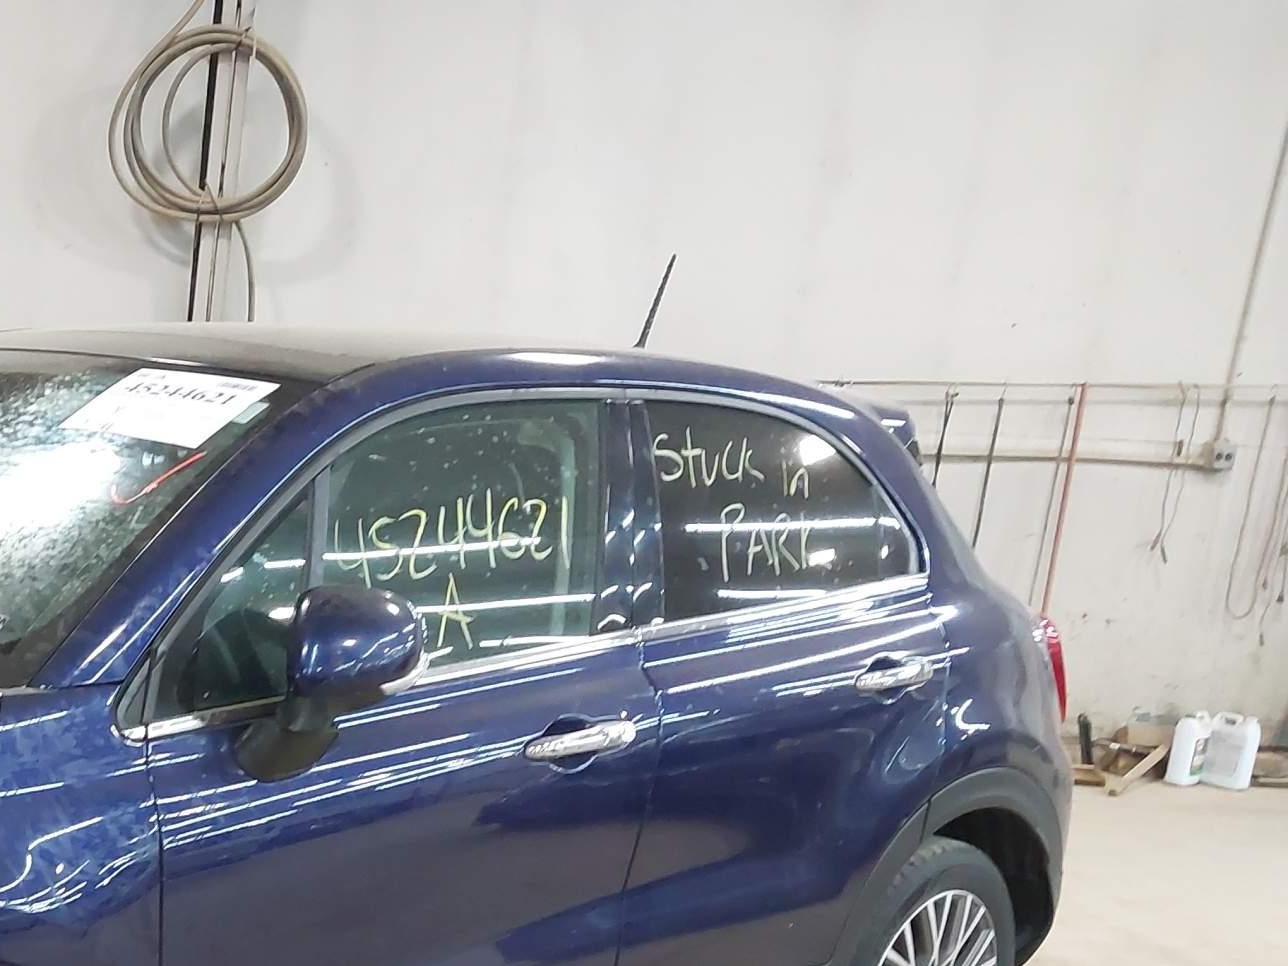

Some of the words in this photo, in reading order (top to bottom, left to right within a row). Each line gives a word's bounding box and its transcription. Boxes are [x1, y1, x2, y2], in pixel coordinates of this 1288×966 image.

[125, 382, 237, 405] 45244621
[653, 425, 765, 489] Stuck
[334, 487, 570, 590] 45244621
